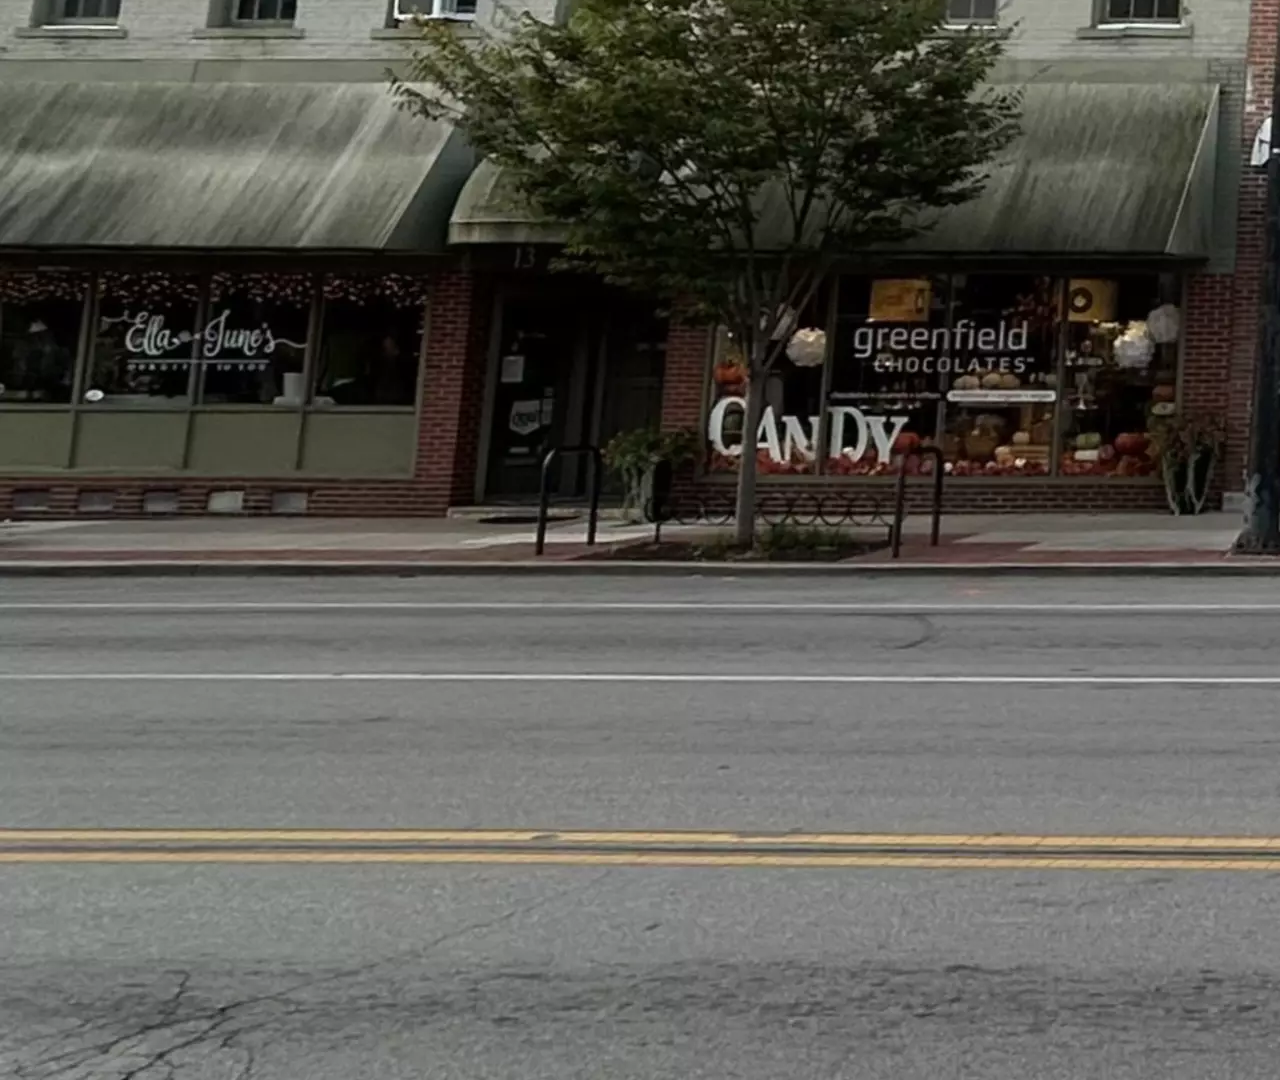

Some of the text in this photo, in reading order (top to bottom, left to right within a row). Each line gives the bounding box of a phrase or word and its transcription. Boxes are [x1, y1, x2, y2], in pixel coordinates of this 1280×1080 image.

[513, 246, 537, 269] 13
[122, 311, 180, 356] Ella
[853, 319, 1029, 359] greenfield
[708, 396, 909, 465] CANDY
